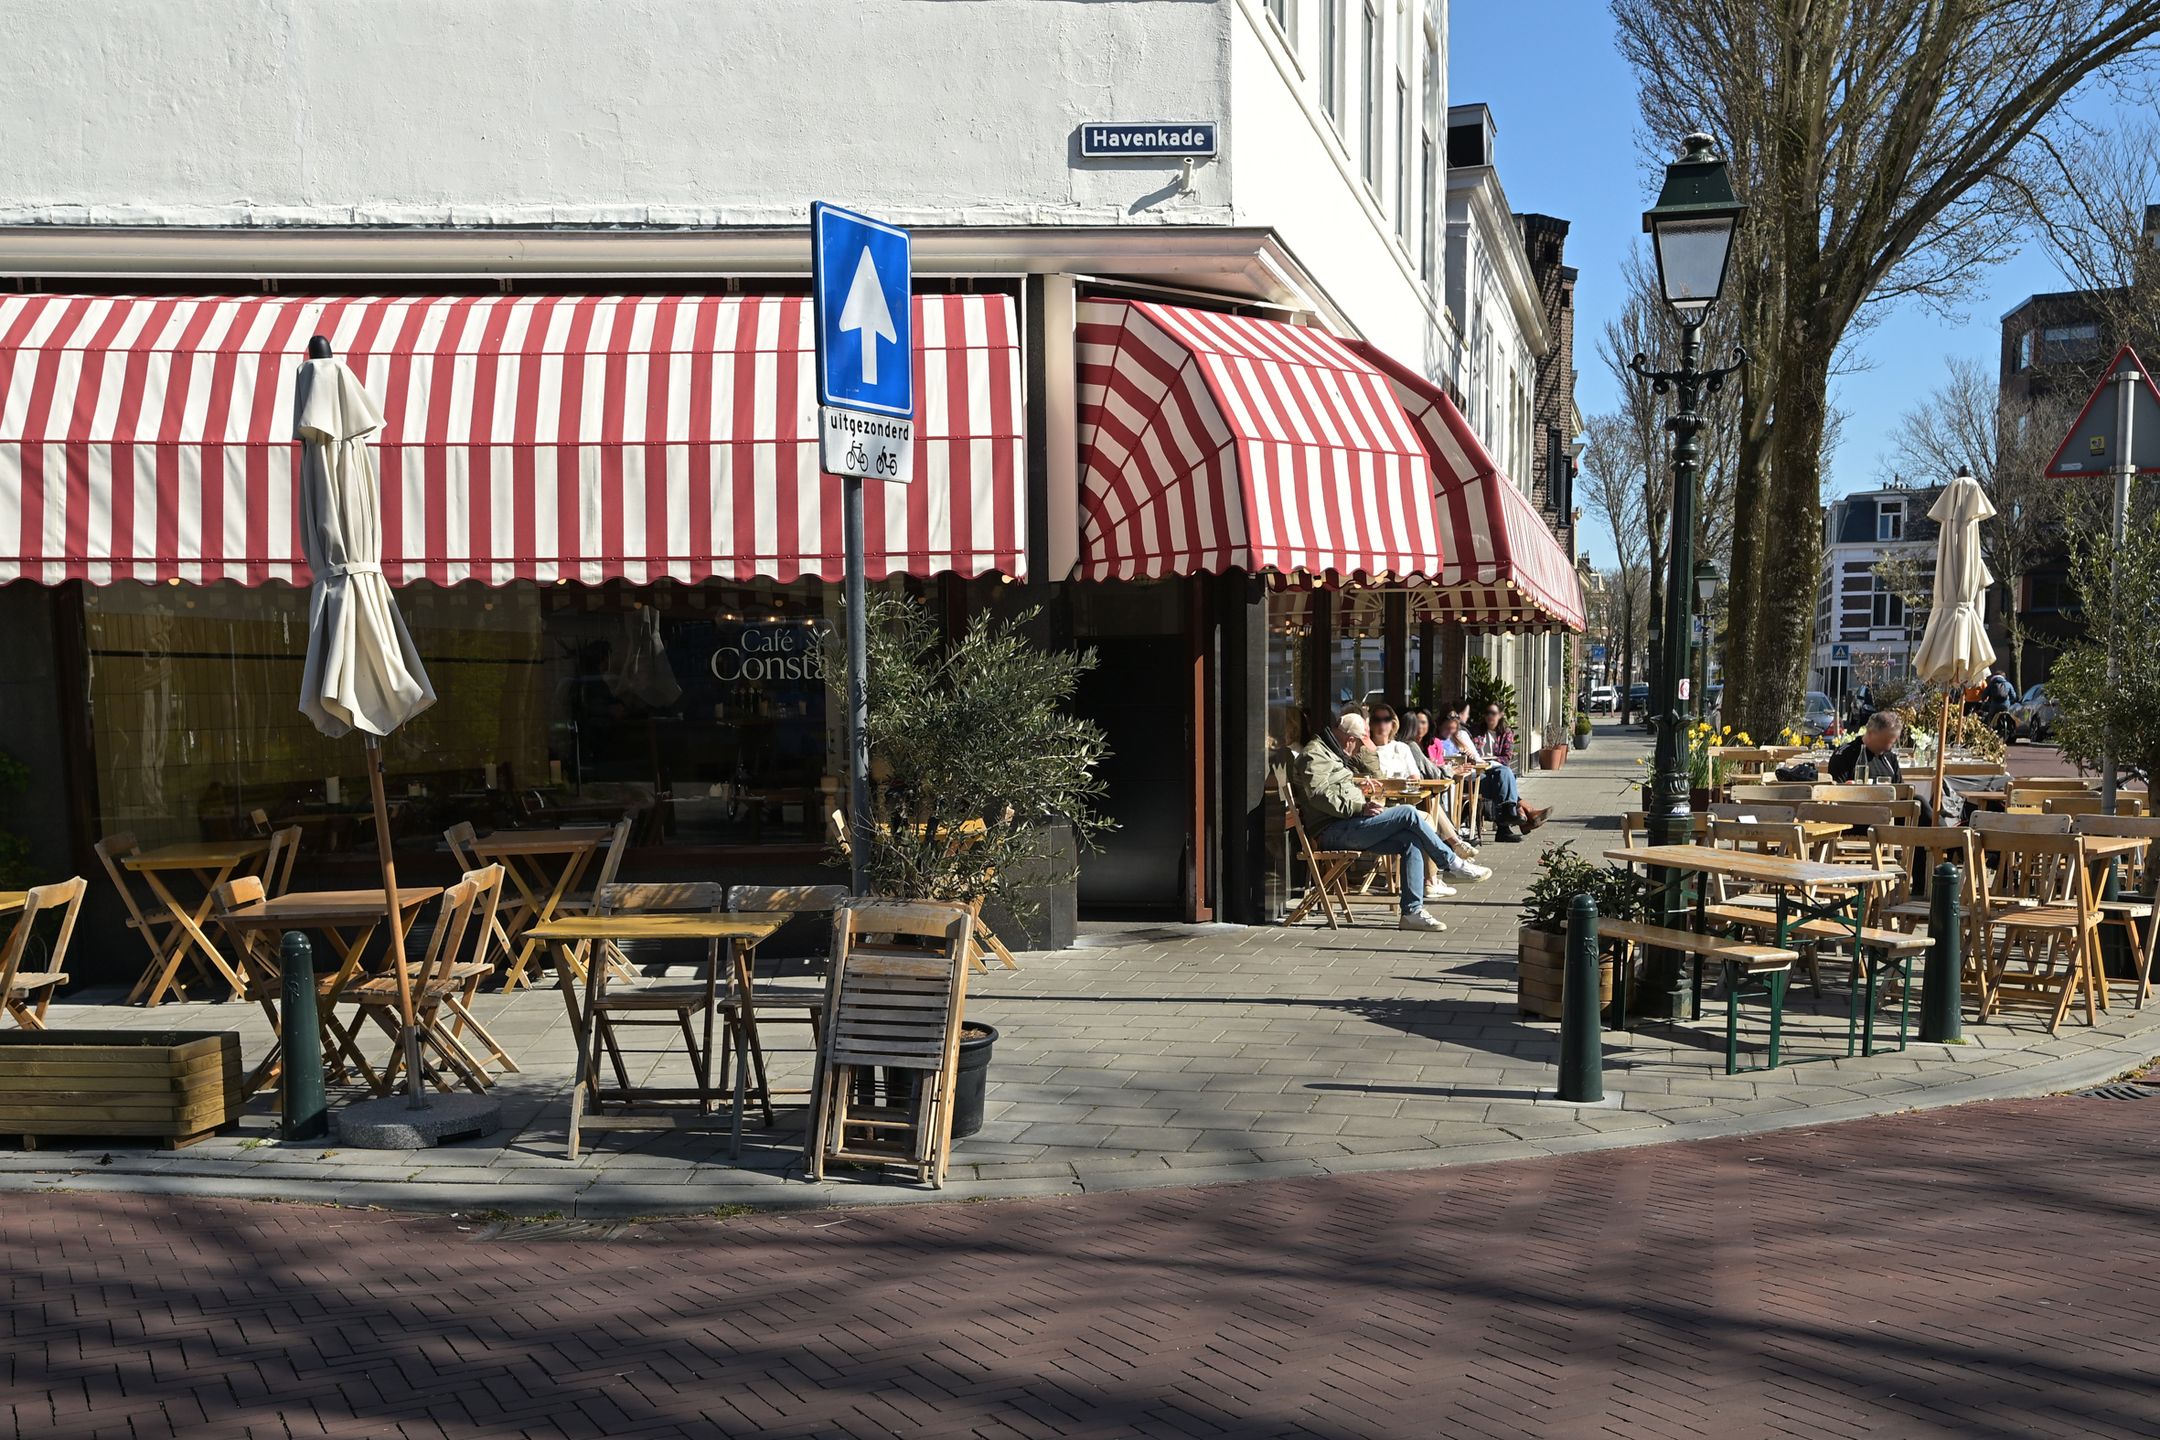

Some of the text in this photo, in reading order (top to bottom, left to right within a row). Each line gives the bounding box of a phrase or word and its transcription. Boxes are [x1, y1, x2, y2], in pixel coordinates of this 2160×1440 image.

[1093, 128, 1205, 147] Havenkade
[831, 413, 909, 440] uitgezonderd
[741, 628, 793, 652] Café
